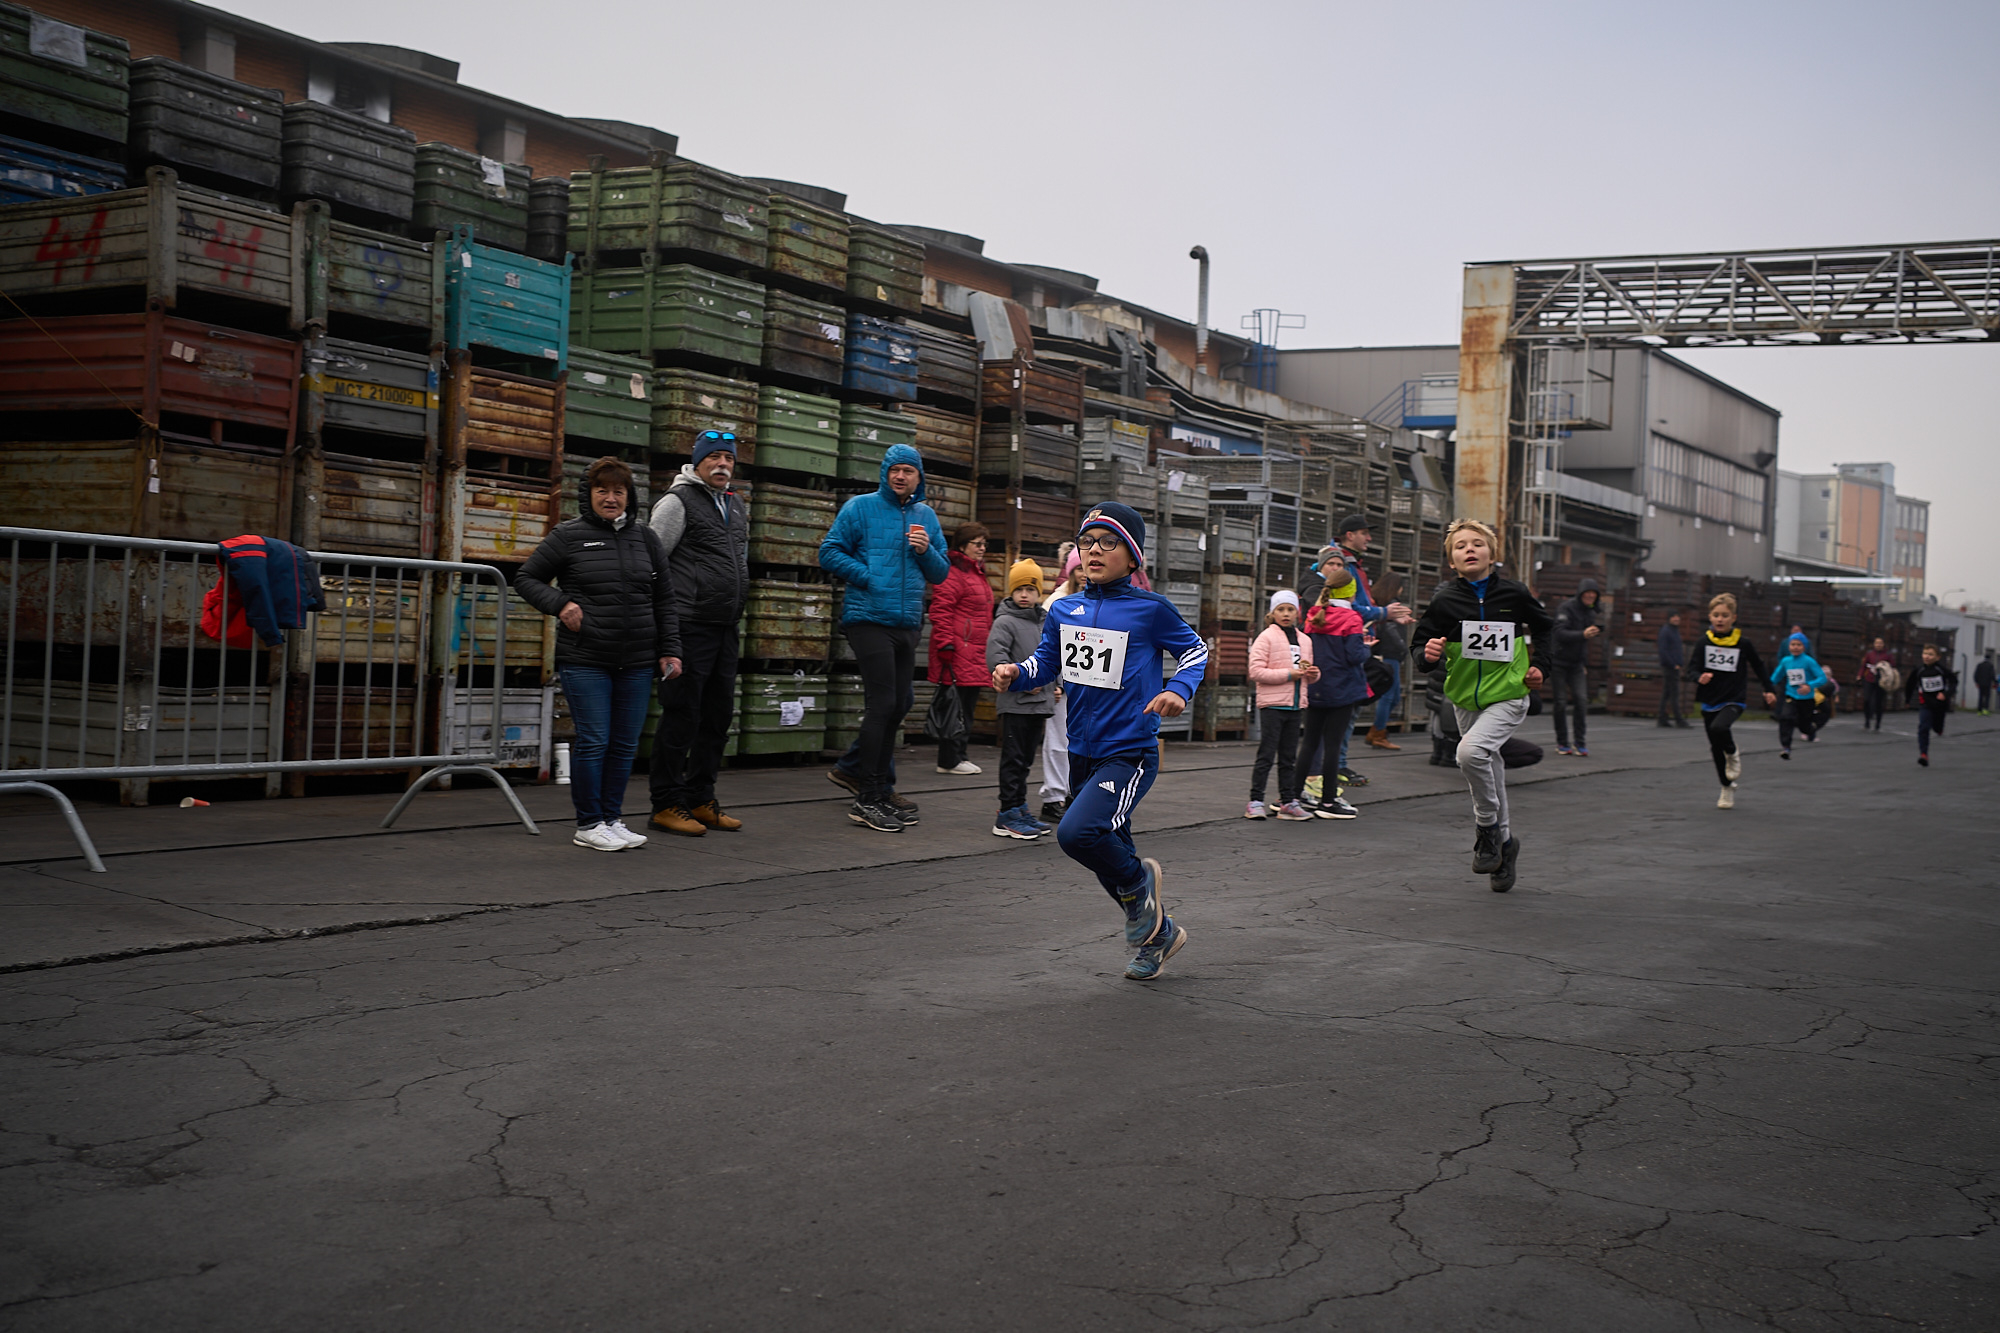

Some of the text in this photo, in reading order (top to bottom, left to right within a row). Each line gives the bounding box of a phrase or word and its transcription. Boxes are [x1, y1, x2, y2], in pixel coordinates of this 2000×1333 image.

[335, 381, 414, 404] MCT 210009
[1074, 630, 1086, 642] K5
[1479, 624, 1489, 632] K5
[1467, 633, 1509, 652] 241
[1065, 642, 1113, 674] 231
[1708, 653, 1735, 666] 234
